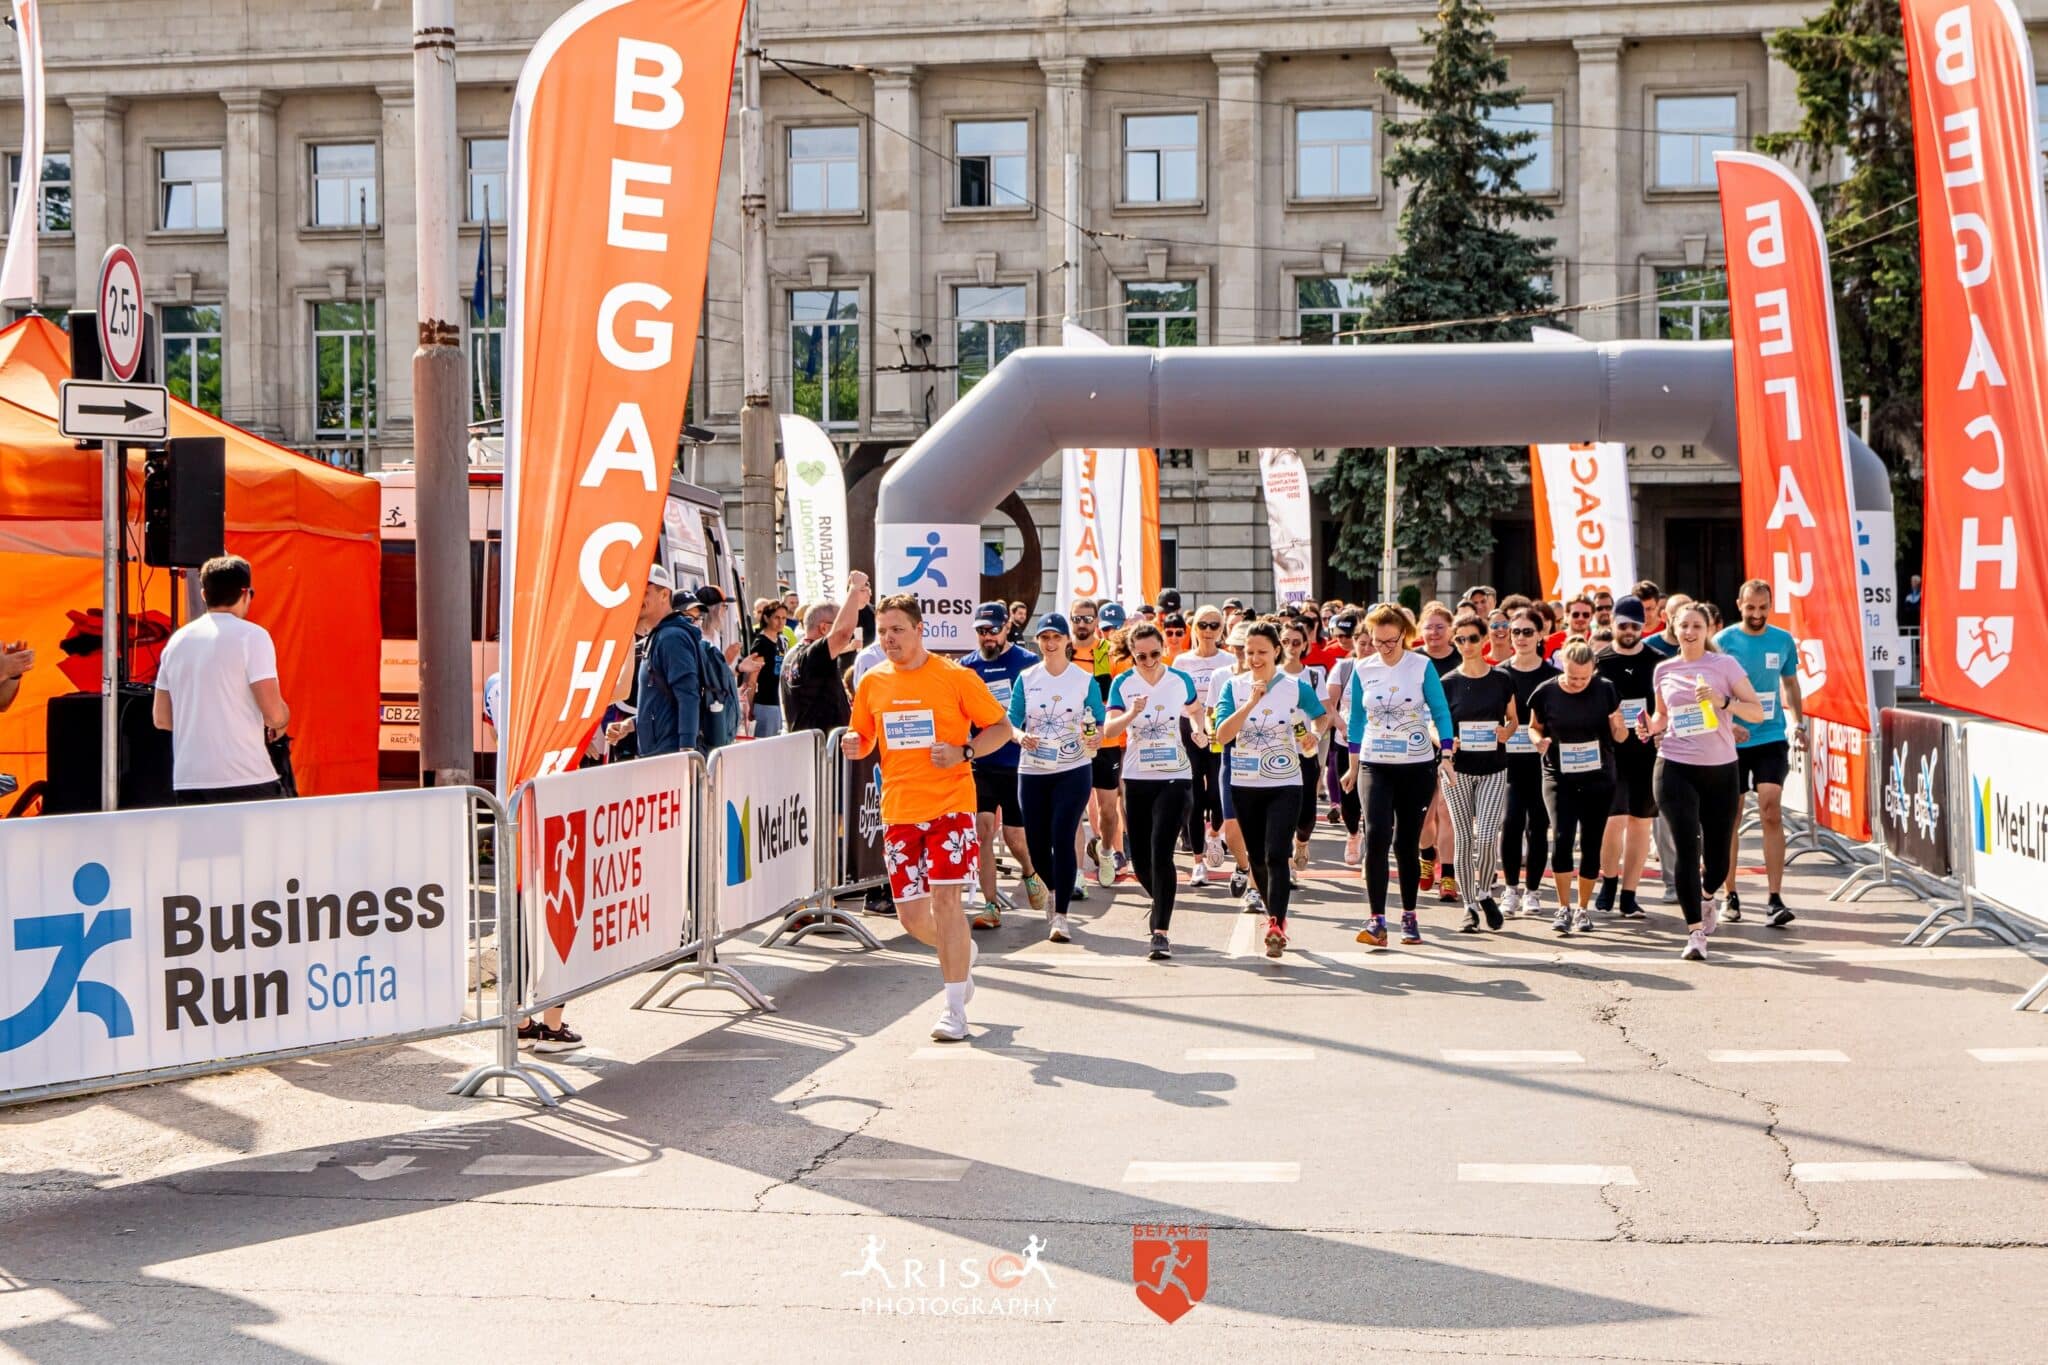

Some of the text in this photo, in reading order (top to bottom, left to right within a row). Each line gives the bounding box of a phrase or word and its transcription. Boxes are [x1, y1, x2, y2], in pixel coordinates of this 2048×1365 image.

[557, 37, 685, 722] BEGACH
[921, 621, 958, 638] Sofia
[593, 788, 681, 847] СПОРТЕН
[757, 793, 809, 864] MetLife
[1996, 792, 2048, 863] MetLif
[593, 846, 642, 899] КЛУБ
[162, 878, 446, 958] Business
[593, 893, 650, 952] БЕГАЧ
[165, 955, 398, 1031] Run Sofia
